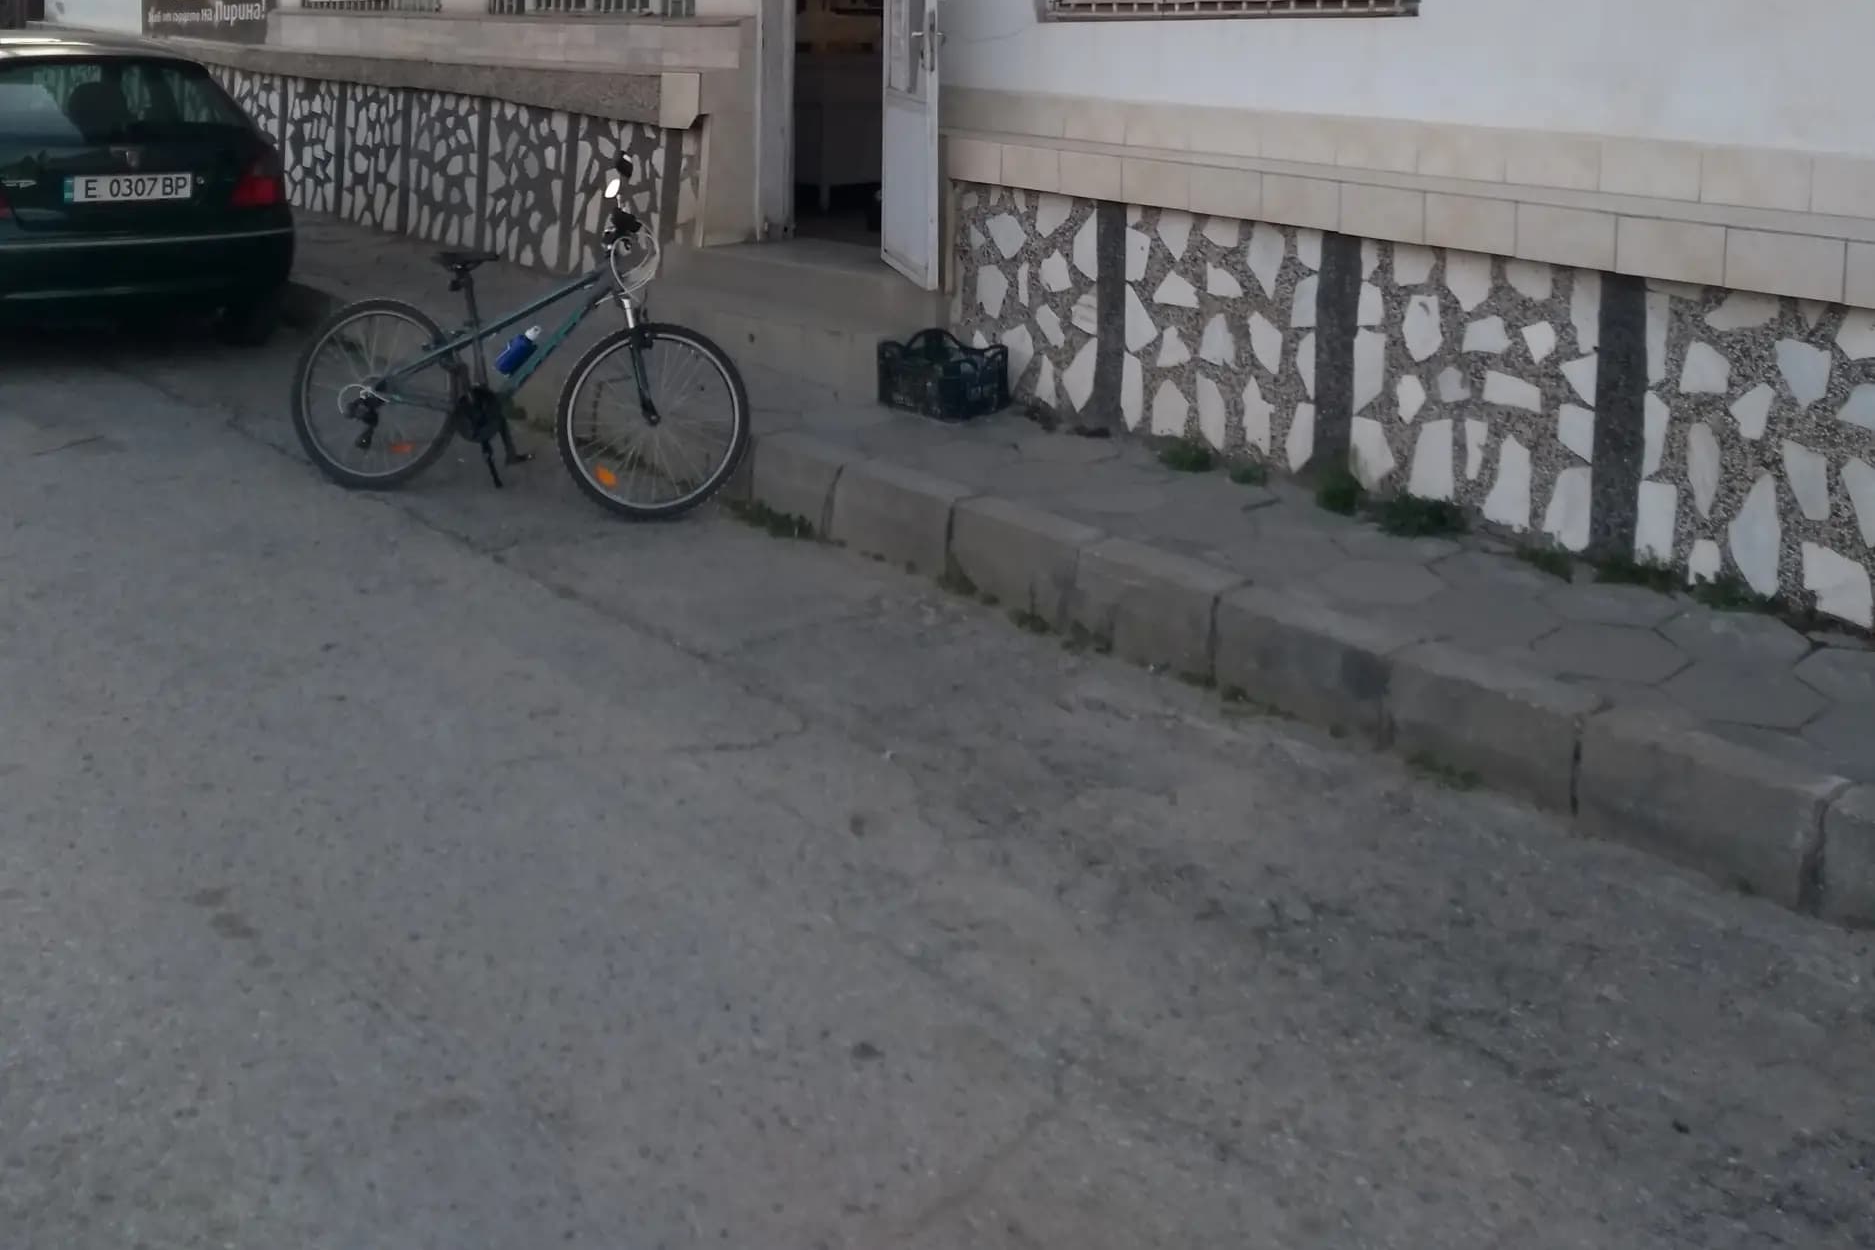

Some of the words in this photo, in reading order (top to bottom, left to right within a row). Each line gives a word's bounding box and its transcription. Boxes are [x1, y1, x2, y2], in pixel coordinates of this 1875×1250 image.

[84, 179, 98, 198] E
[109, 177, 158, 198] 0307
[162, 177, 187, 196] BP
